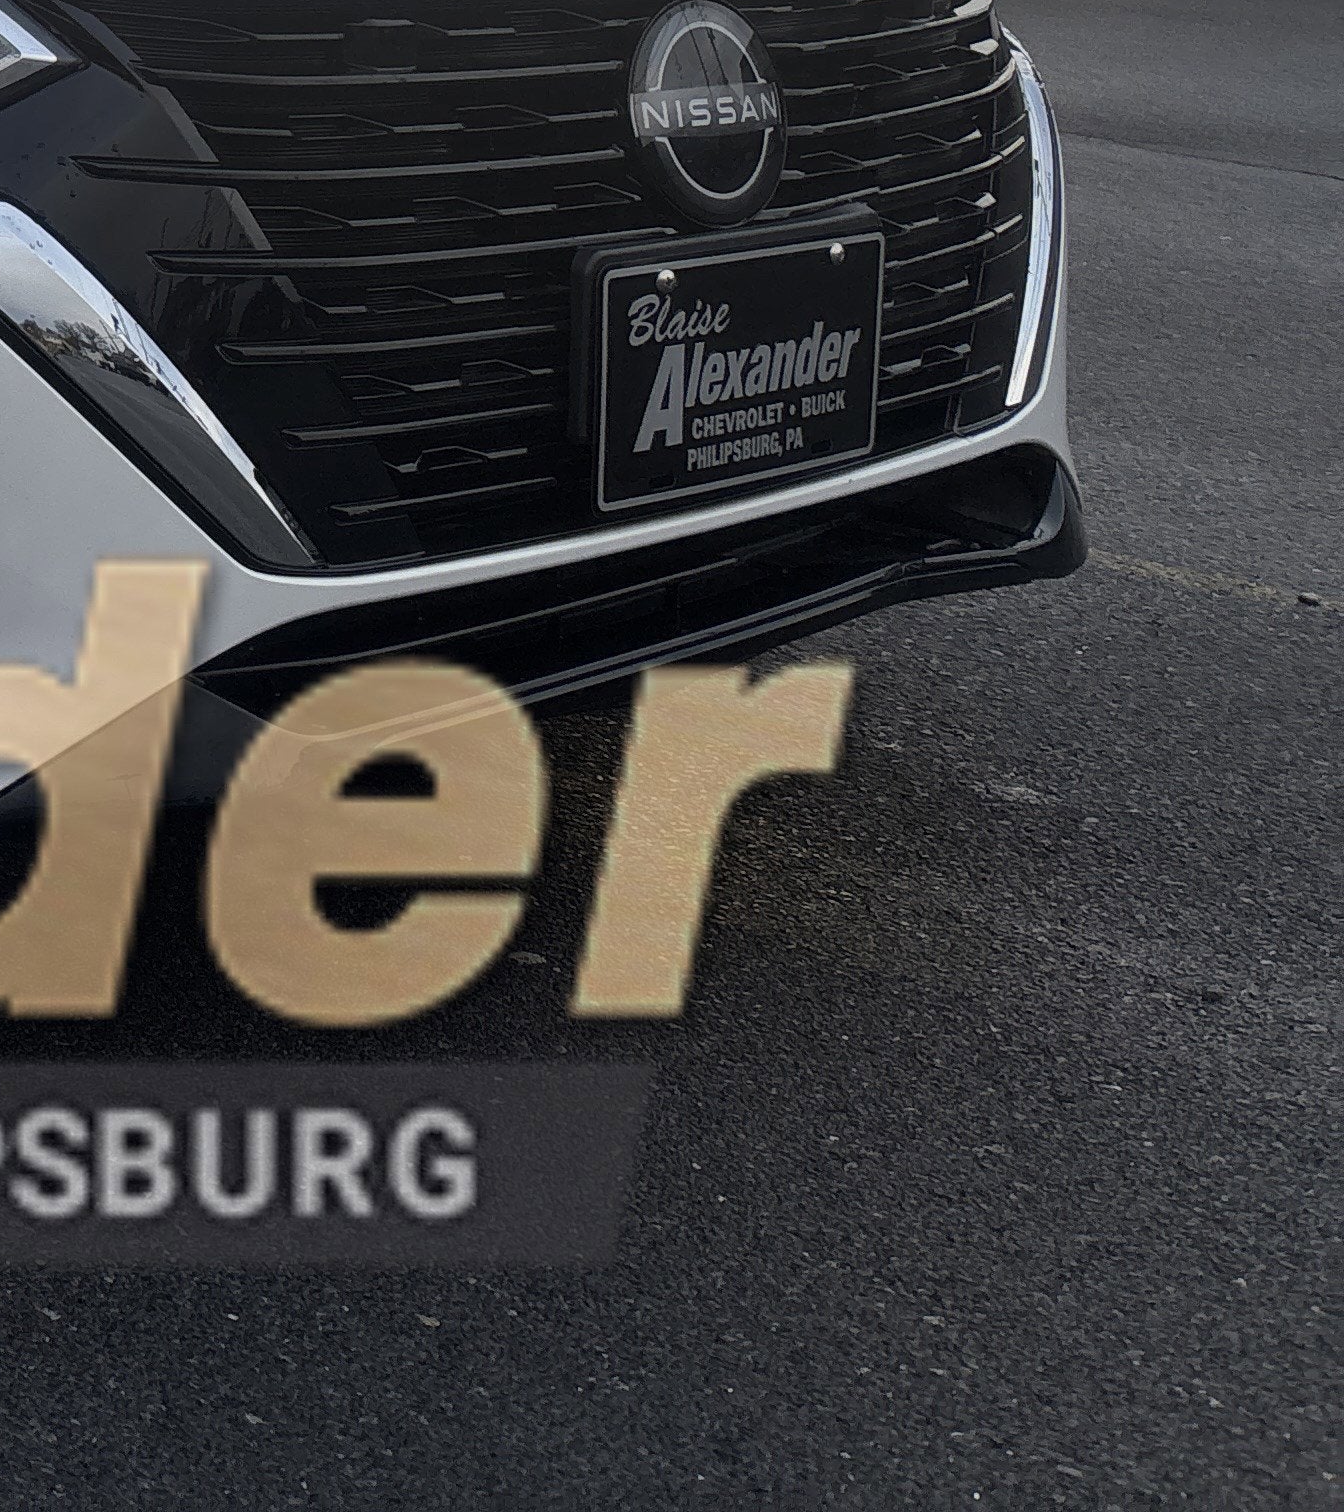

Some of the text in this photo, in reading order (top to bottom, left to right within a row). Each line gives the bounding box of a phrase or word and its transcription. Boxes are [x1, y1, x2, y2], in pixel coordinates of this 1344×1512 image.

[640, 91, 778, 131] NISSAN
[628, 293, 730, 347] Blaise
[632, 320, 861, 453] Alexander
[691, 389, 847, 440] CHEVROLET BUICK
[686, 426, 804, 472] PHILIPSBURG, PA
